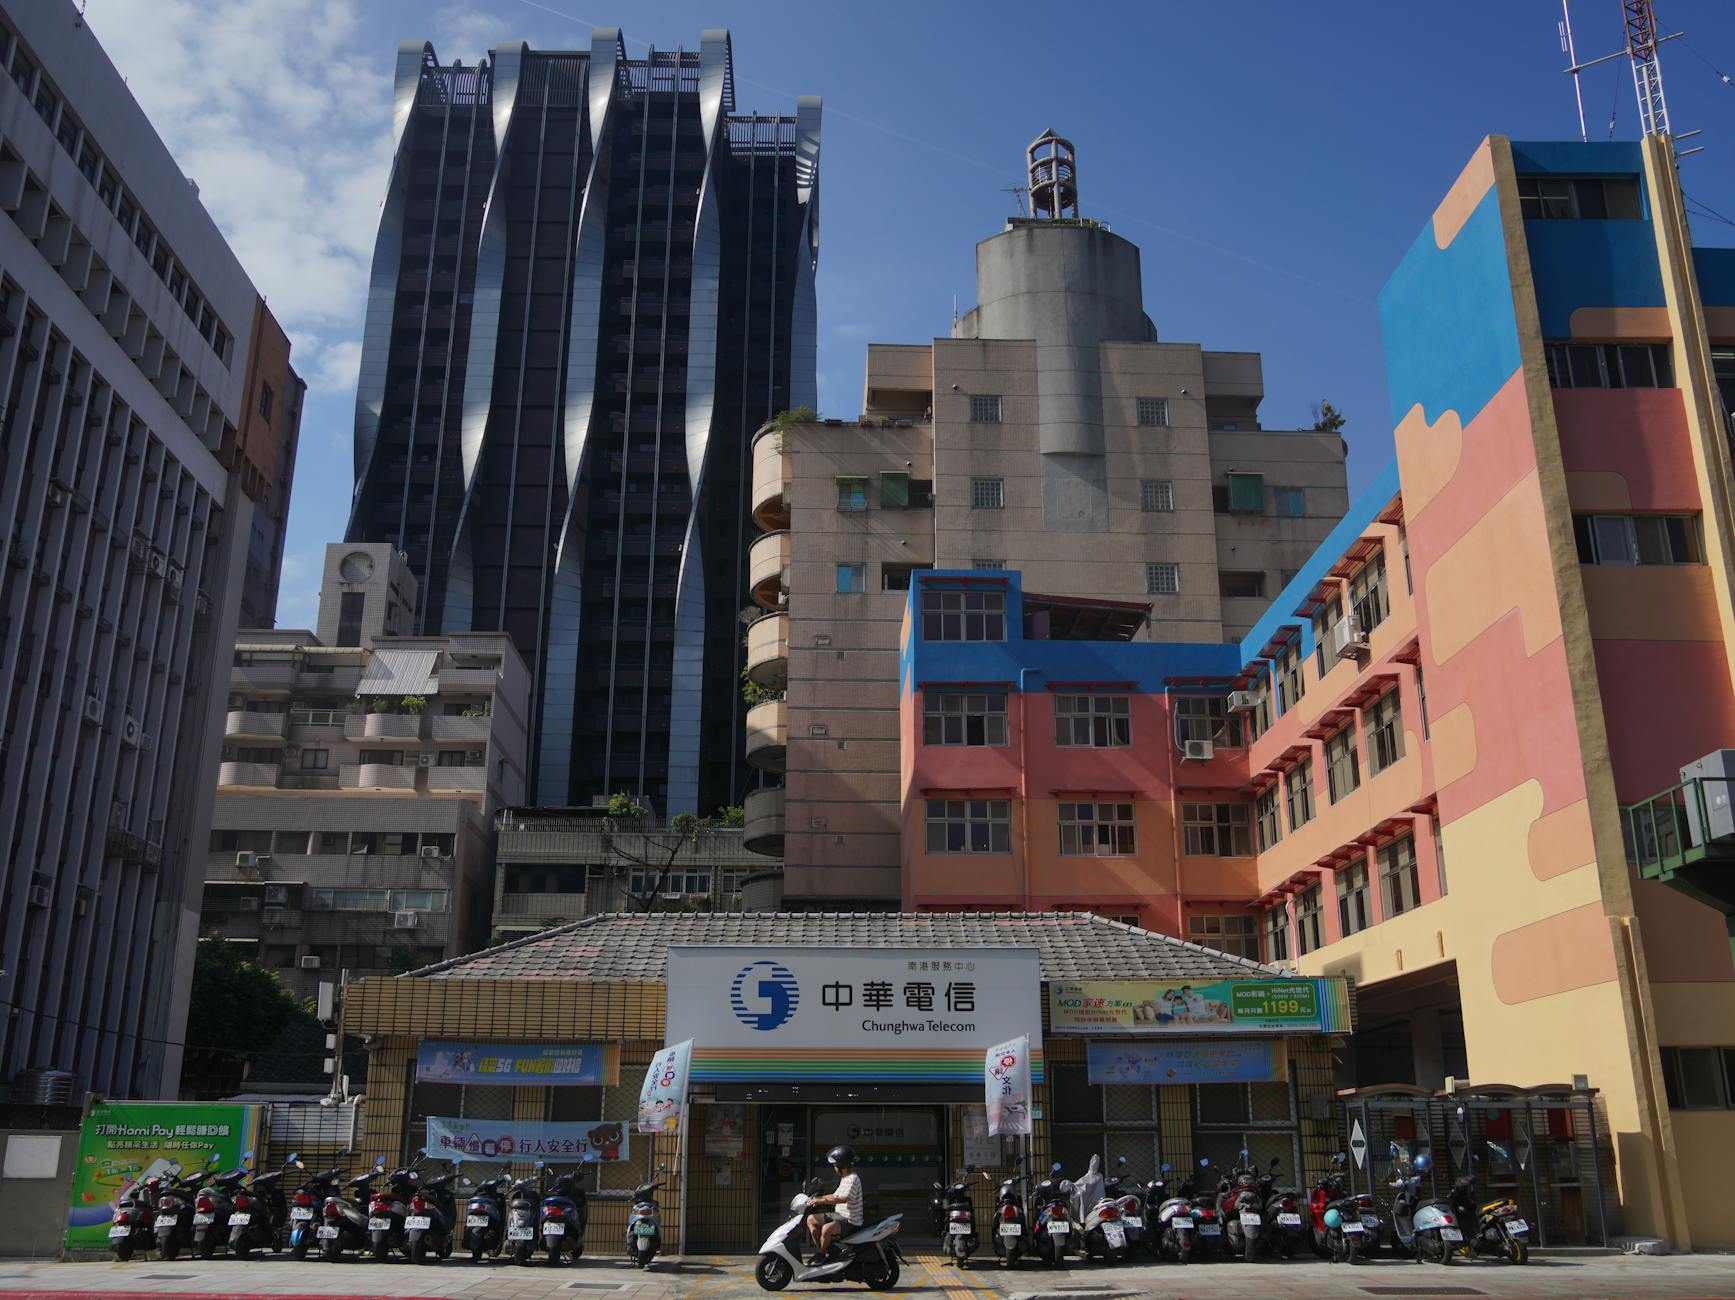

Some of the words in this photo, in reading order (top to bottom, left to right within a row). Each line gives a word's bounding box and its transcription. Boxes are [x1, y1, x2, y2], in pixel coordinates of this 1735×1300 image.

[908, 961, 976, 972] 南港服務中心
[821, 981, 976, 1012] 中華電信
[862, 1020, 925, 1035] Chunghwa
[926, 1020, 976, 1033] Telecom
[151, 1124, 174, 1138] Pay
[519, 1138, 588, 1154] 行人安全行
